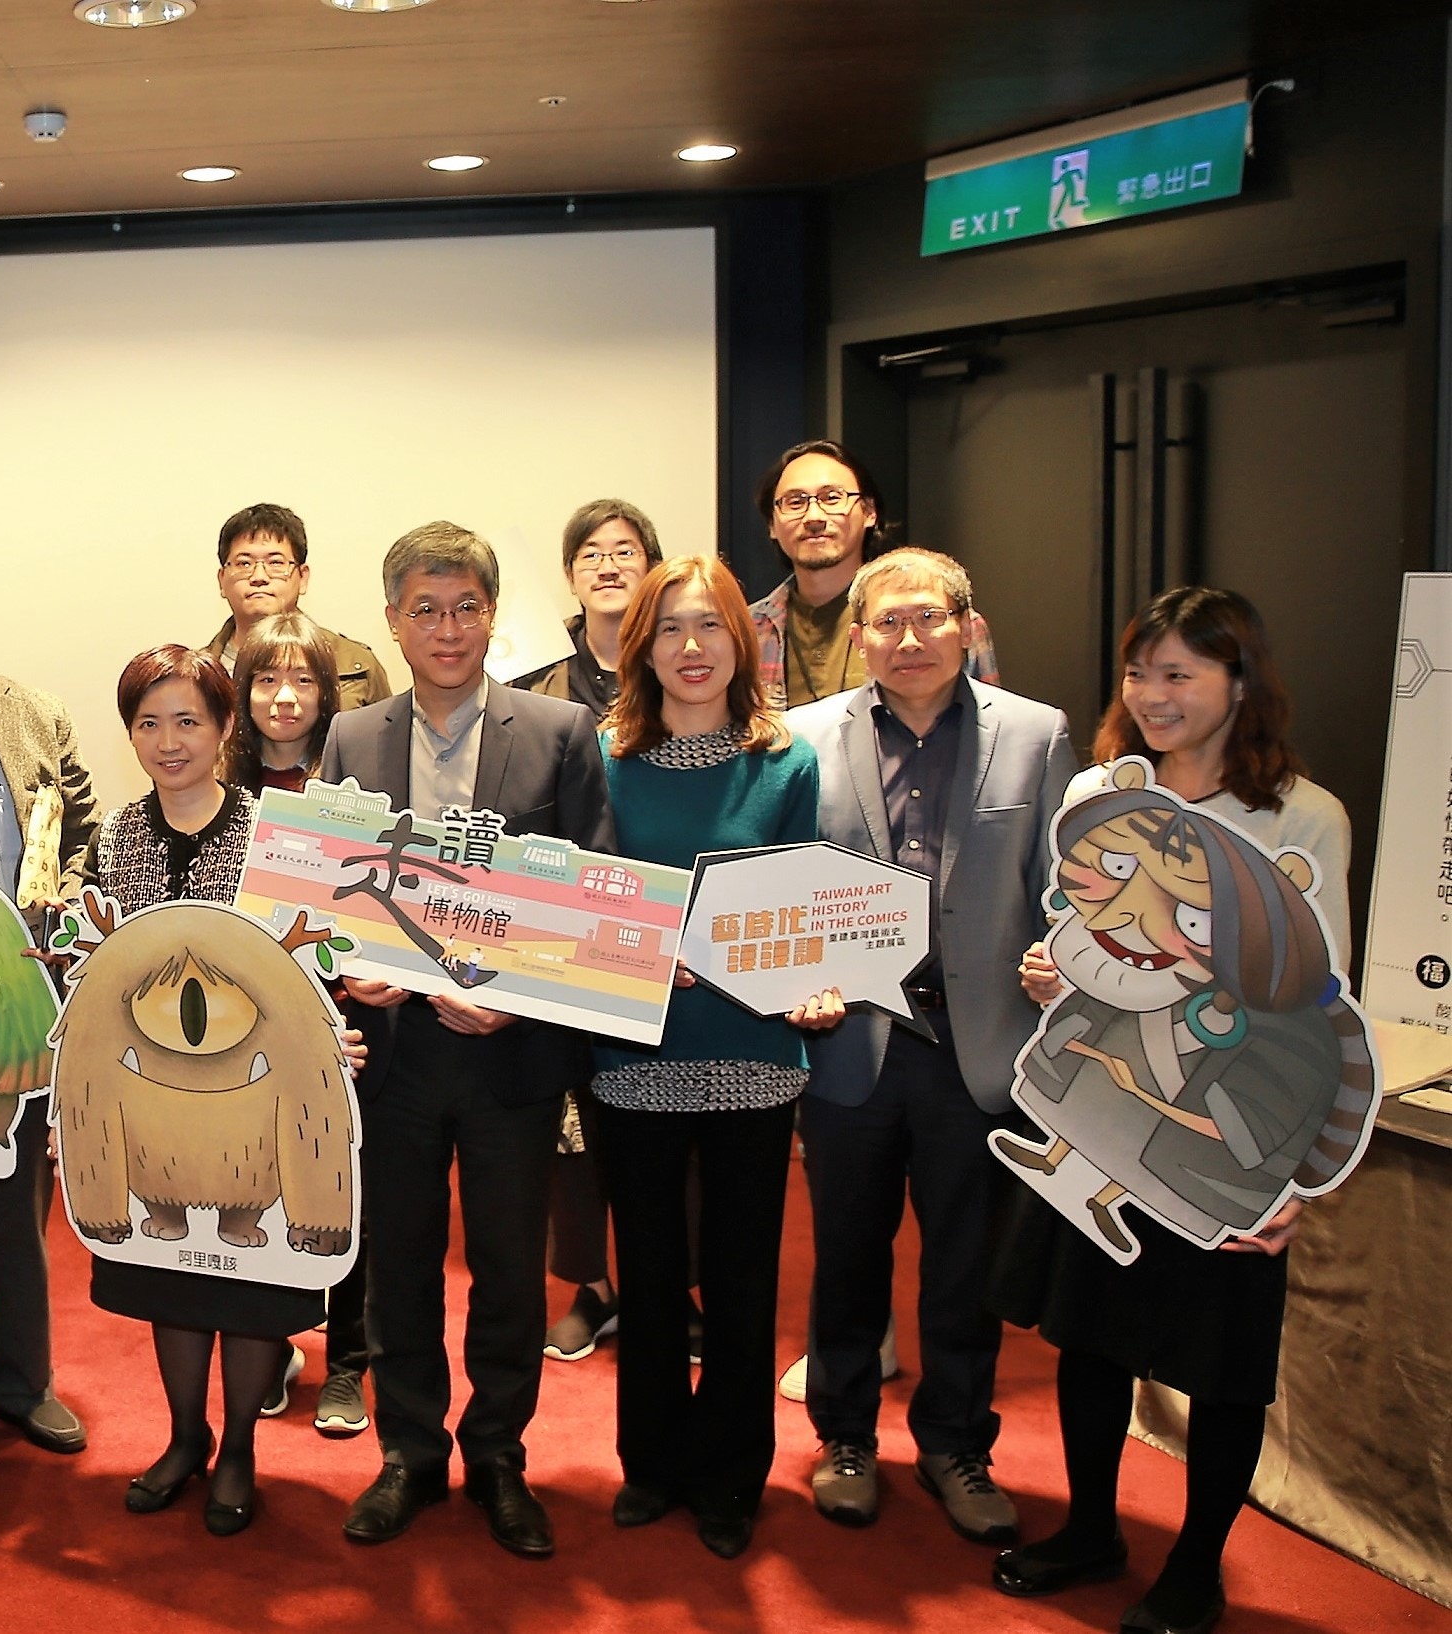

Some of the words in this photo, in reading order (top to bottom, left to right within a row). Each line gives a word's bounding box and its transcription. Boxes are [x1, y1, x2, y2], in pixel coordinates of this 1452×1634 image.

[1116, 162, 1212, 206] 緊急出口
[950, 206, 1021, 241] EXIT
[427, 883, 459, 899] LET'S
[463, 891, 485, 904] GO!
[812, 887, 863, 901] TAIWAN
[866, 883, 893, 895] ART
[423, 895, 511, 938] 博物館
[811, 901, 869, 916] HISTORY
[810, 920, 824, 931] IN
[828, 917, 854, 929] THE
[857, 911, 908, 925] COMICS
[1422, 959, 1446, 984] 福
